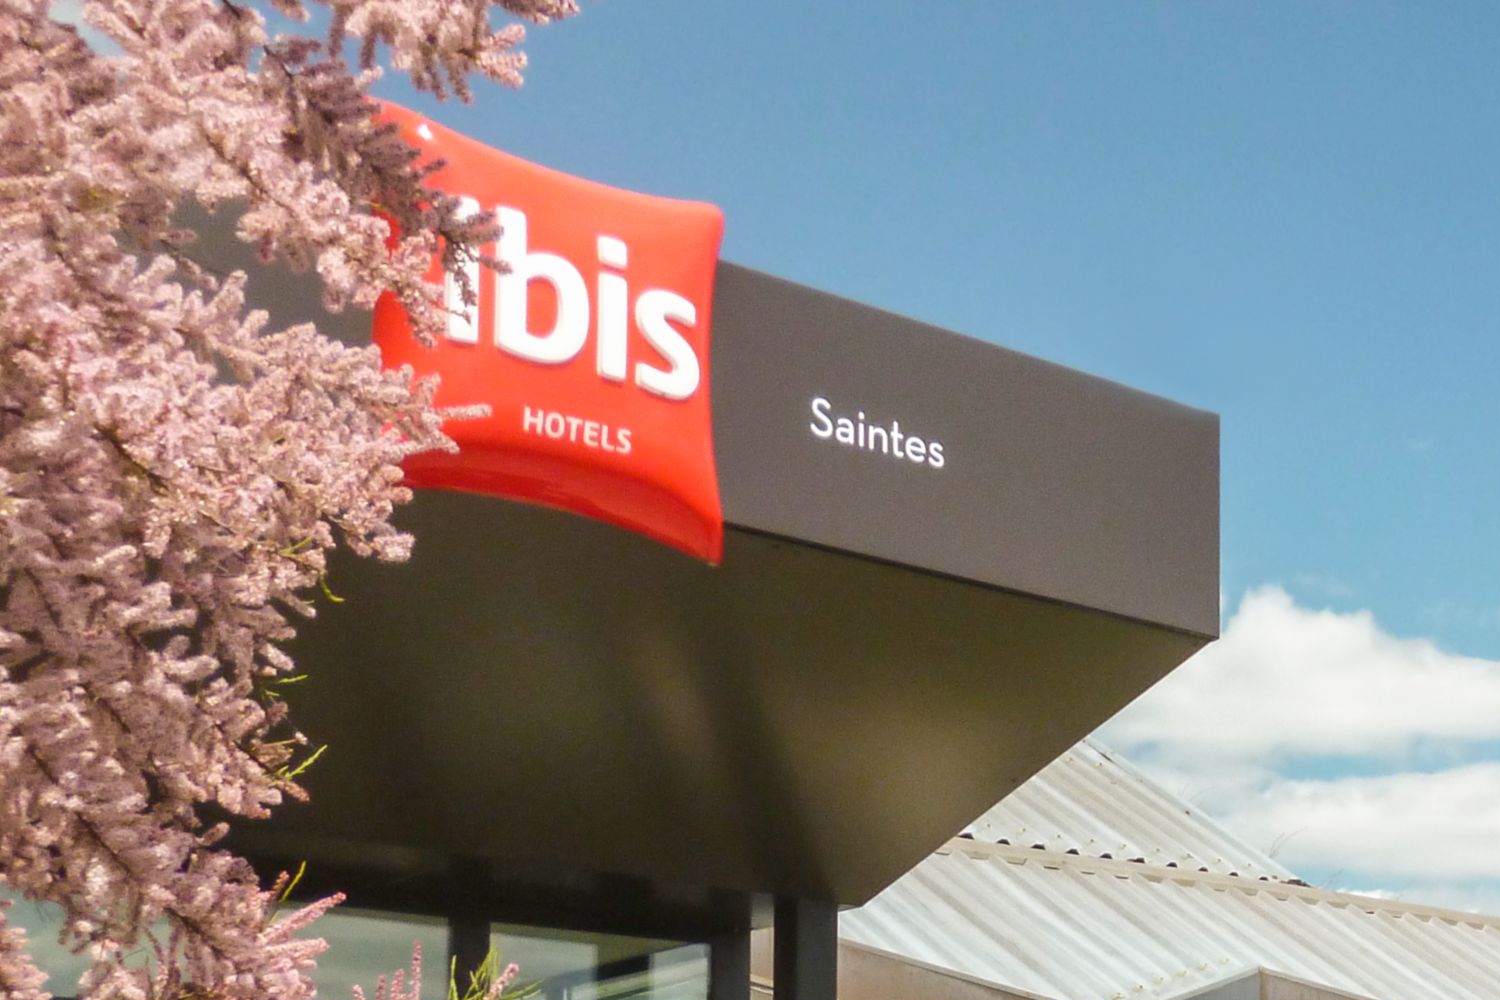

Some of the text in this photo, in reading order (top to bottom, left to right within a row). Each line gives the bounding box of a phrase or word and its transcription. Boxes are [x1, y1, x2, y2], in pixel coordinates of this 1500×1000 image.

[444, 196, 700, 400] ibis
[523, 406, 632, 455] HOTELS
[809, 397, 945, 468] Saintes
